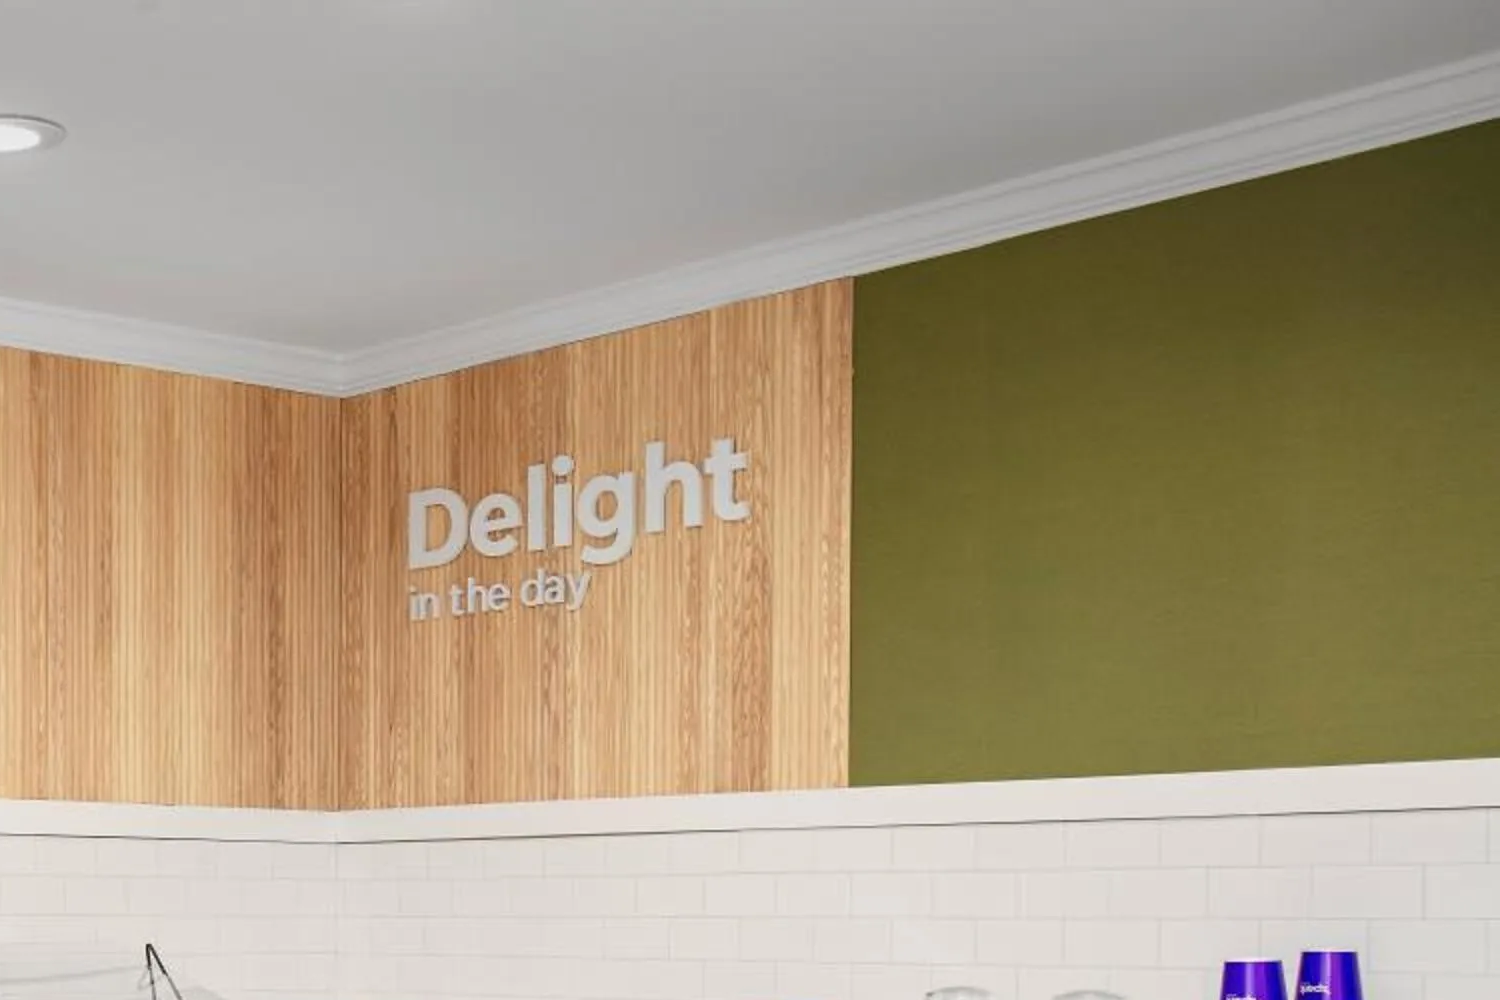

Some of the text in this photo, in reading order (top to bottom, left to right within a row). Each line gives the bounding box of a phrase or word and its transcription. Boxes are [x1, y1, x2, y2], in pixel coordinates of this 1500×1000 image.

[408, 437, 750, 570] Delight
[409, 567, 591, 621] in the day
